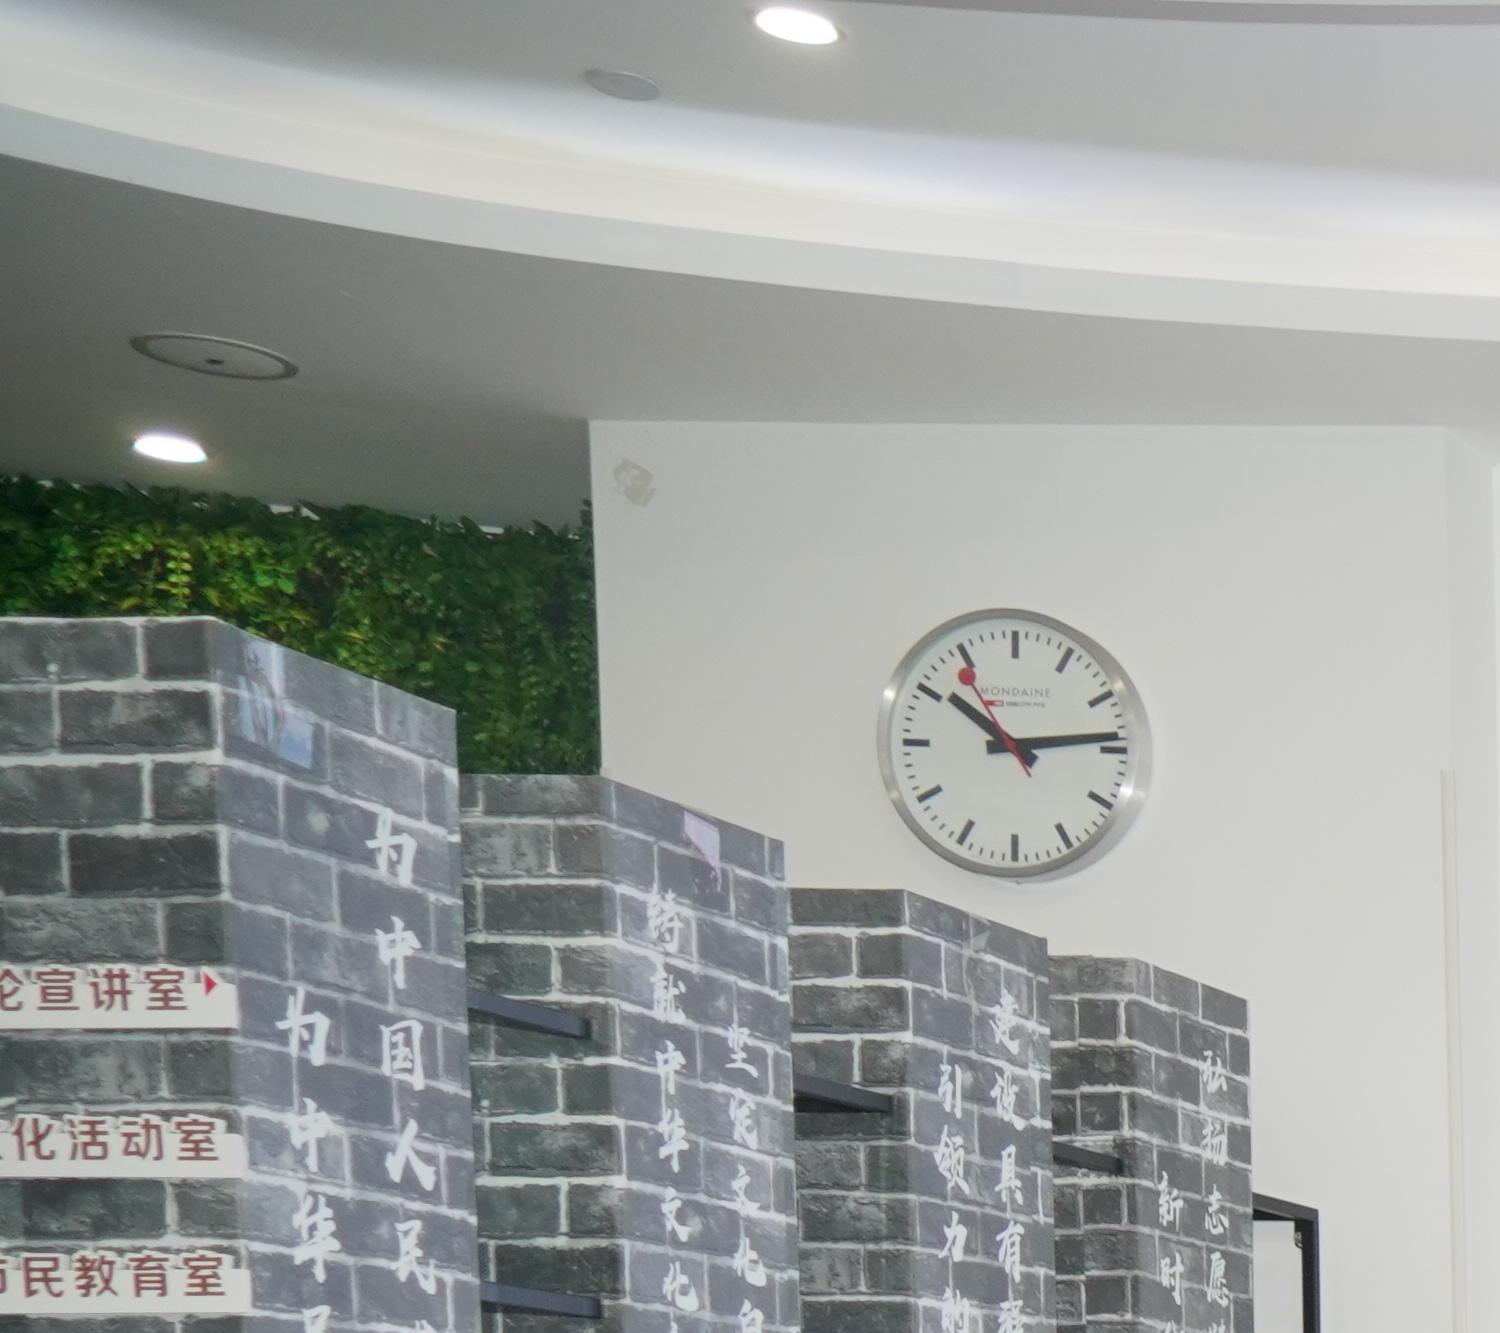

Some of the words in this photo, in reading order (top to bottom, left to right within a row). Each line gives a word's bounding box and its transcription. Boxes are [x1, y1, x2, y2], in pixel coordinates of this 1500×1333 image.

[0, 1116, 220, 1163] 化活动室
[0, 1253, 227, 1299] 民教育室
